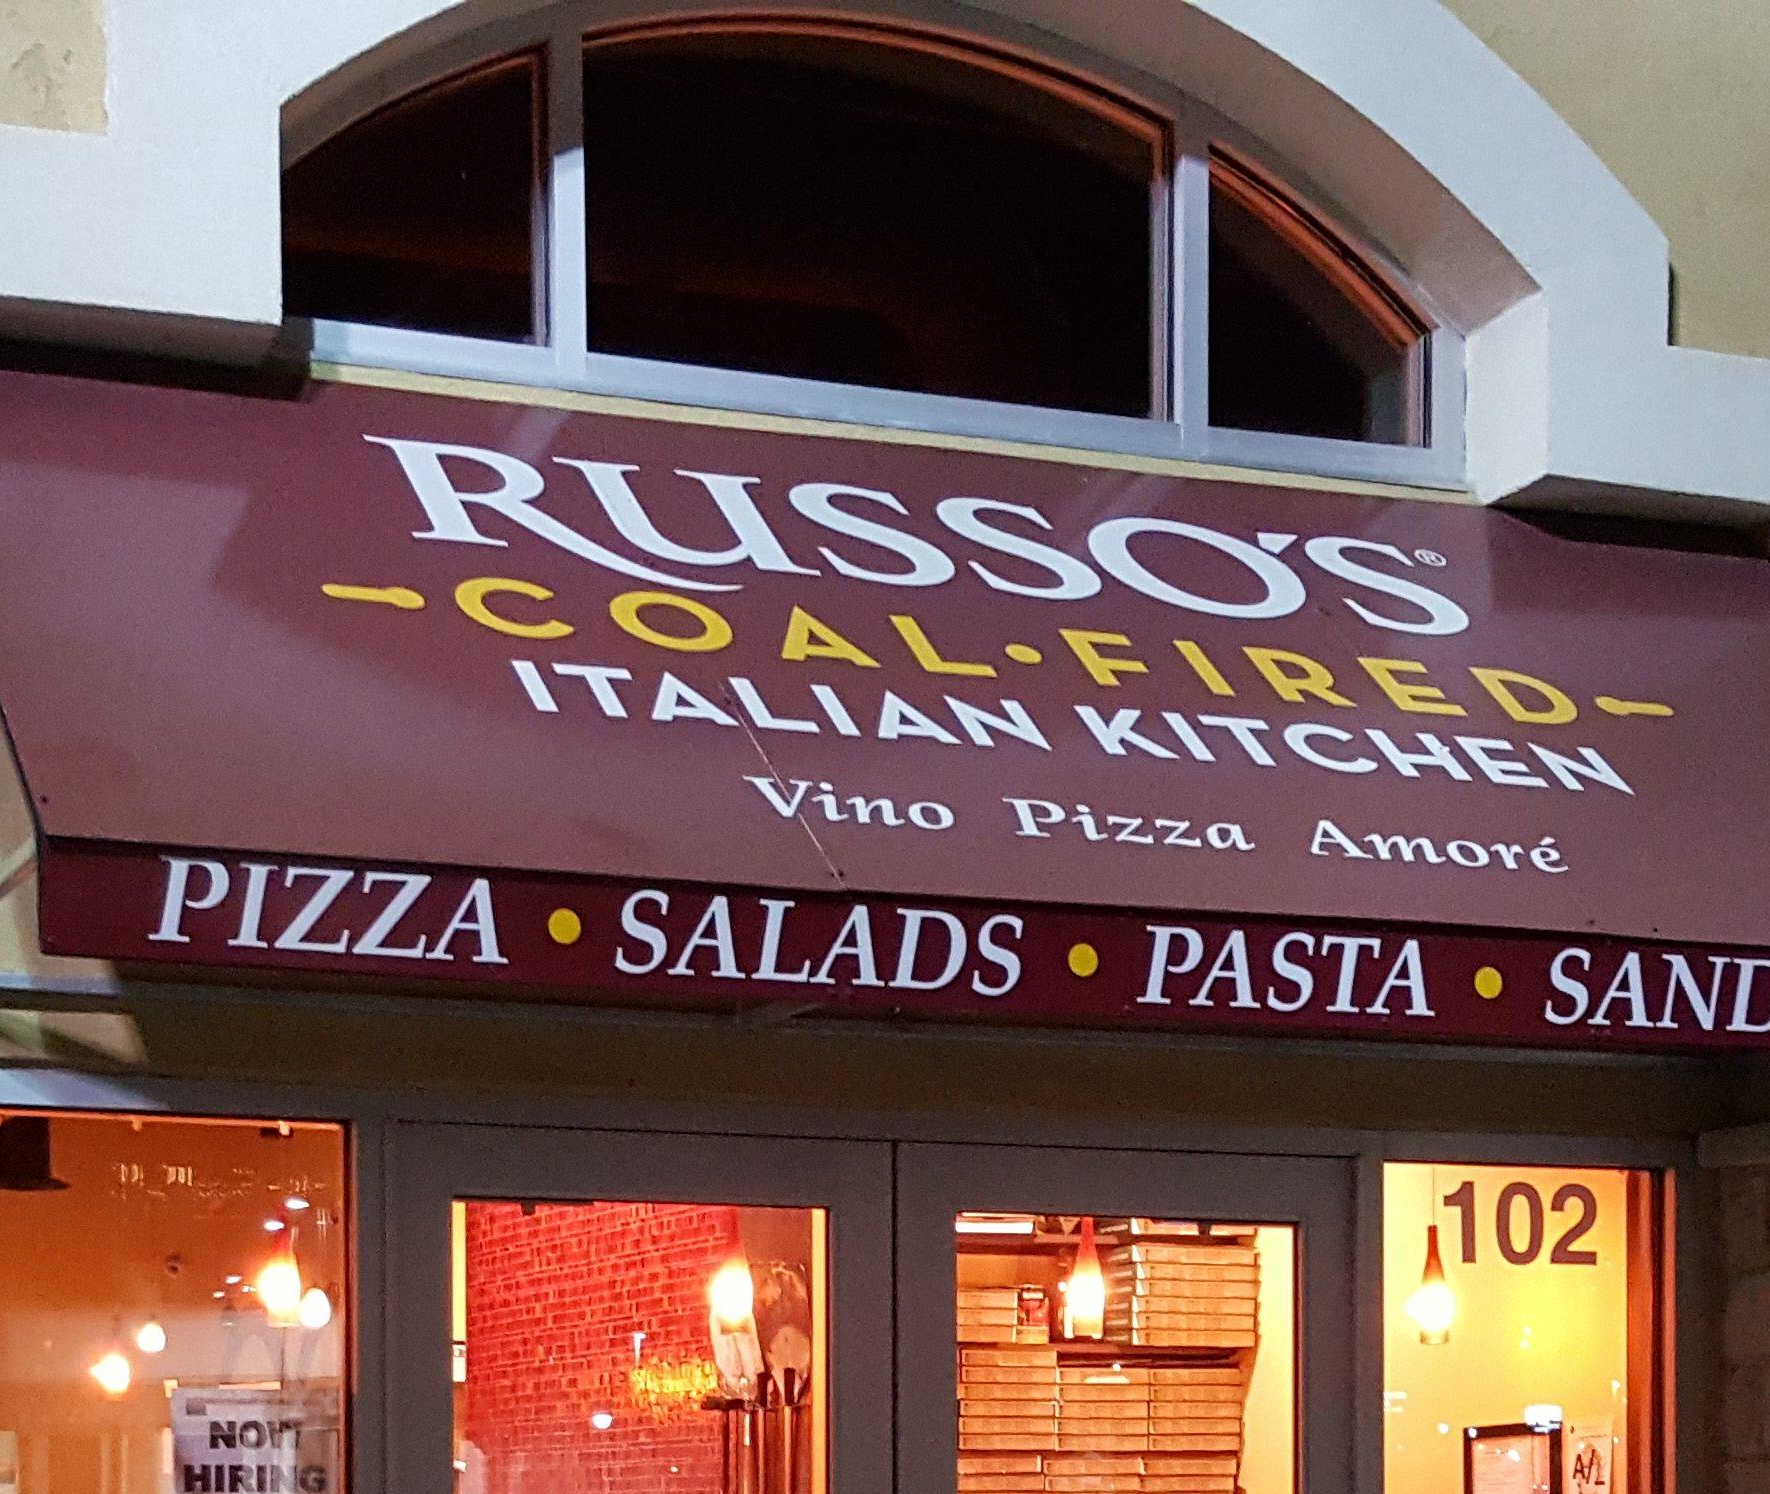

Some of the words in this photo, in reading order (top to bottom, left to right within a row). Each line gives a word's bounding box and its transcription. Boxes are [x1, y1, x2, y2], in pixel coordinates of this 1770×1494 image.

[363, 434, 1470, 637] RUSSO'S
[511, 659, 1053, 752] ITALIAN
[1074, 704, 1635, 796] KITCHEN
[743, 774, 955, 832] Vino
[1003, 796, 1256, 853] Pizza
[1310, 817, 1570, 874] Amoré
[147, 854, 510, 967] PIZZA
[613, 888, 1025, 997] SALADS
[1135, 924, 1436, 1018] PASTA
[1442, 1180, 1599, 1266] 102
[182, 1463, 328, 1494] HIRING
